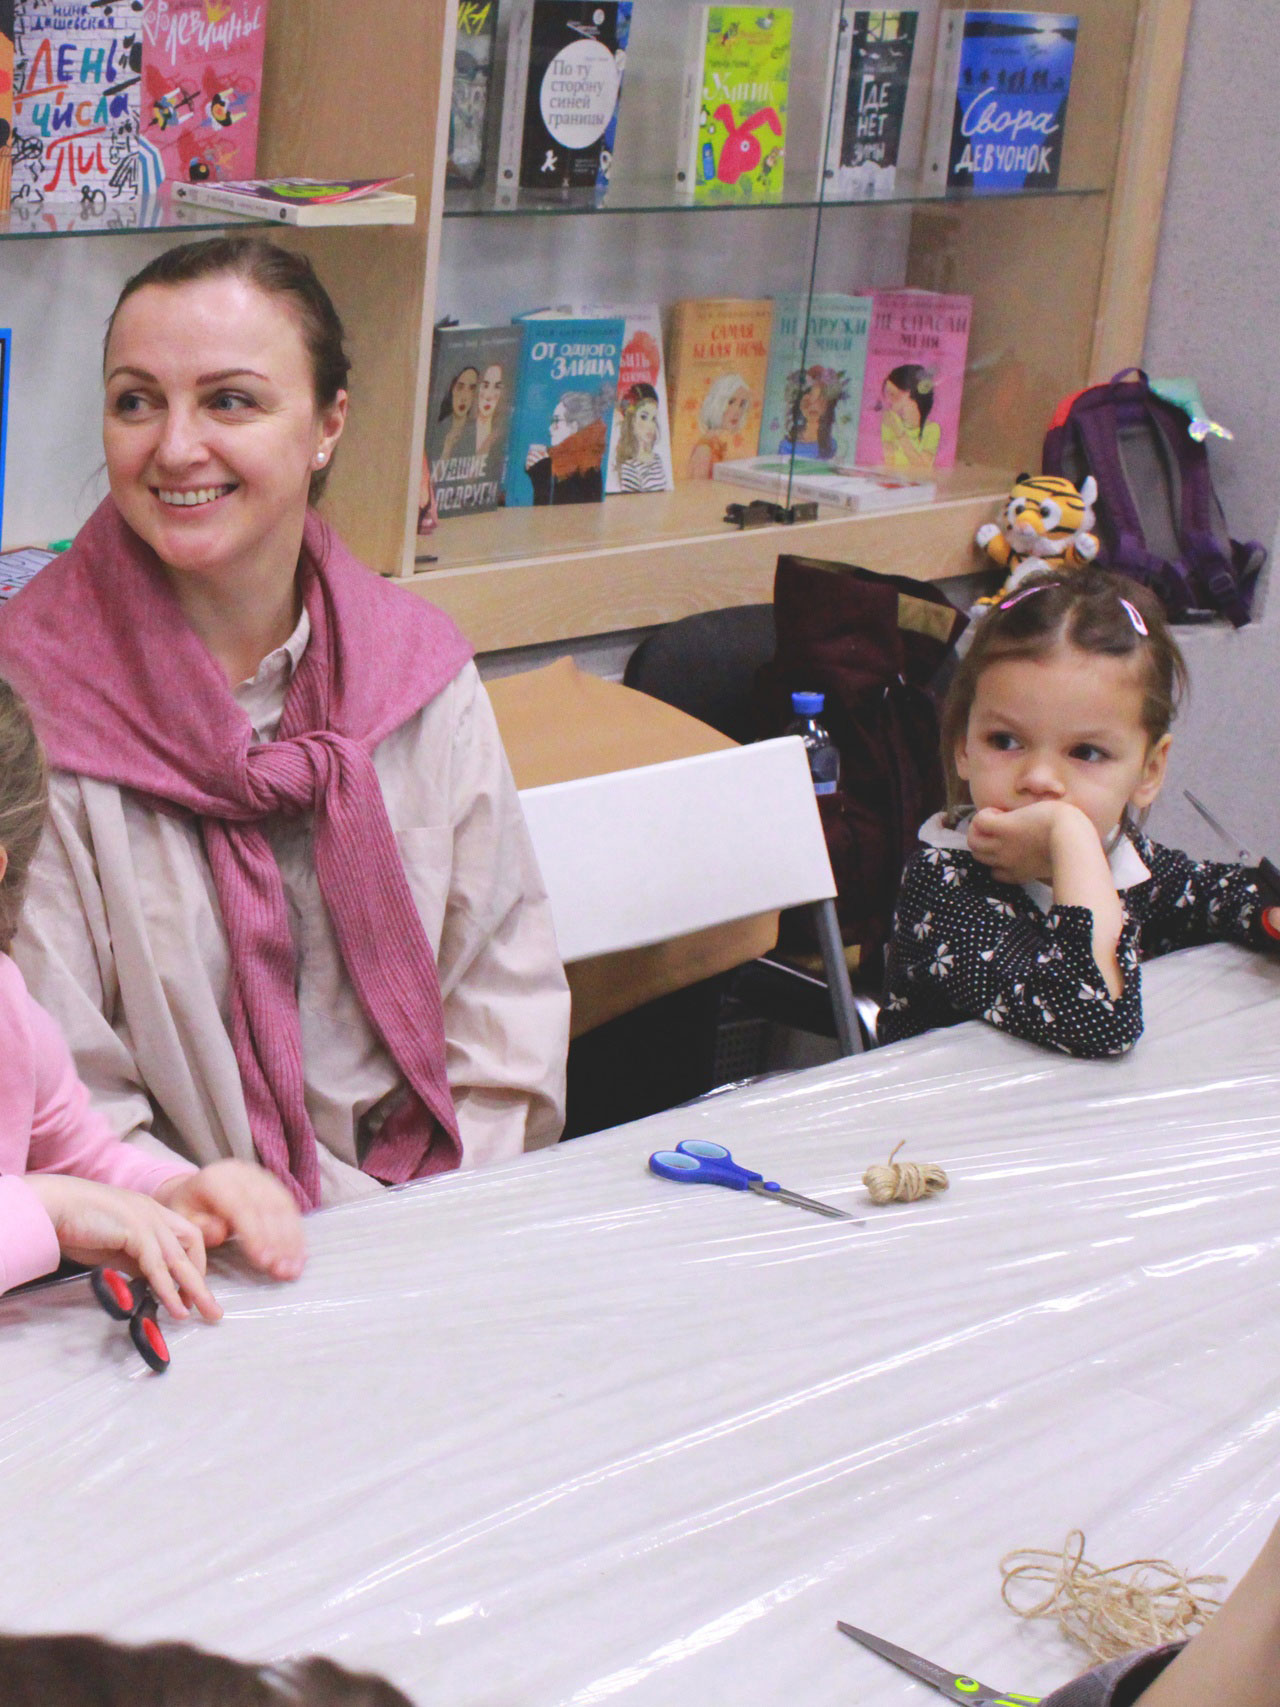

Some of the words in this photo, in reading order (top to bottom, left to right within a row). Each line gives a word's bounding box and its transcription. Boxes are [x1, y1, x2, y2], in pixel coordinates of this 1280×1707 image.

[552, 60, 573, 76] По
[576, 65, 592, 80] ту
[550, 79, 605, 96] сторону
[549, 96, 591, 110] синей
[547, 112, 605, 129] границы
[960, 87, 1059, 141] Свора
[430, 454, 488, 482] ХУДШИЕ
[435, 482, 498, 511] ПОДРУГИ
